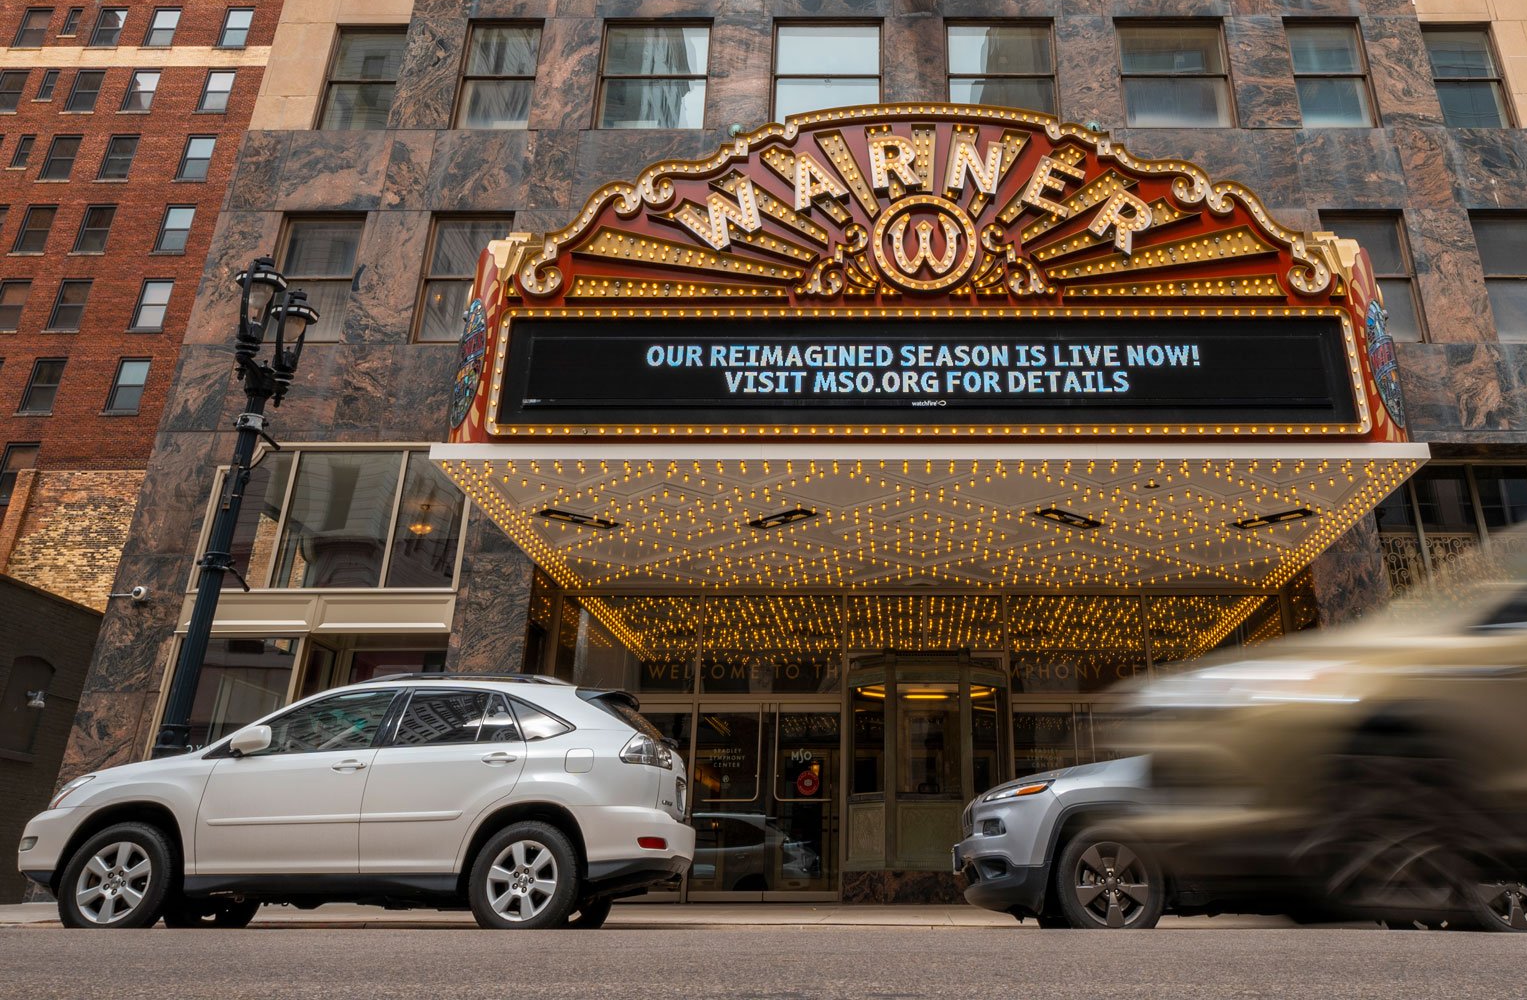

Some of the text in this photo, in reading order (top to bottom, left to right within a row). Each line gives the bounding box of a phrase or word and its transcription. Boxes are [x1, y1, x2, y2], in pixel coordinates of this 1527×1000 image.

[675, 135, 1153, 256] WARNER
[646, 345, 1201, 367] OUR REIMAGINED SEASON IS LIVE NOW!
[725, 371, 1130, 393] VISIT MSO.ORG FOR DETAILS
[773, 664, 801, 680] TO
[791, 748, 812, 763] MSO
